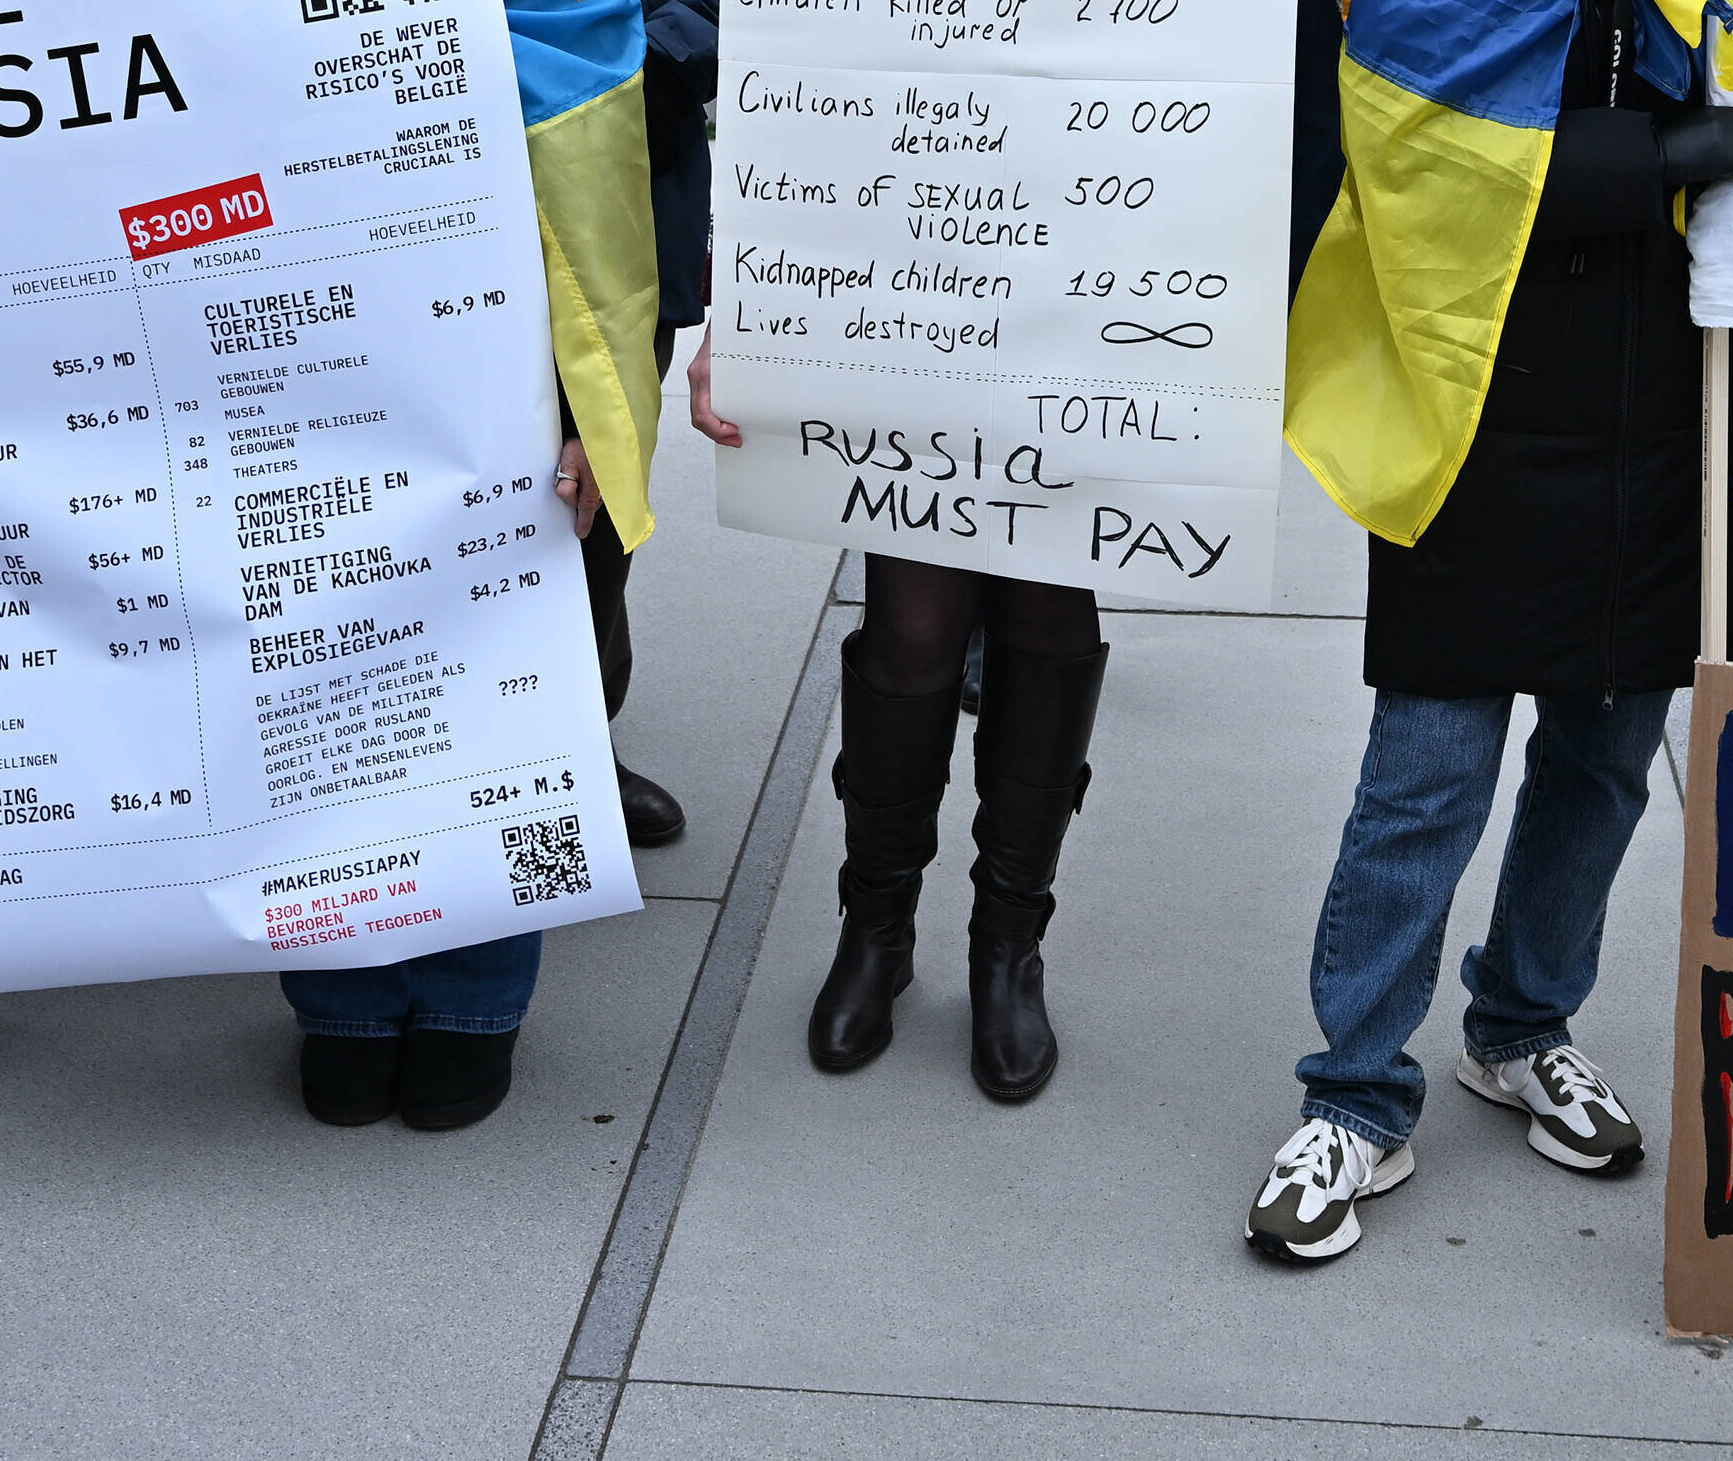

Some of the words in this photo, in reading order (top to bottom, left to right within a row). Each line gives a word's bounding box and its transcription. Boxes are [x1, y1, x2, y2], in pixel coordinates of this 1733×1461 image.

[360, 30, 385, 48] DE
[396, 17, 458, 43] WEVER
[911, 20, 1019, 49] injured
[314, 43, 423, 77] OVERSCHAT
[437, 38, 461, 56] DE
[416, 58, 465, 81] VOOR
[395, 76, 468, 105] BELGIË
[738, 71, 874, 119] Civilians
[896, 88, 990, 126] illegaly
[1067, 101, 1108, 131] 20
[1132, 101, 1210, 133] 000
[892, 126, 1007, 155] detained
[736, 164, 836, 205] Victims
[1065, 176, 1154, 210] 500
[126, 204, 215, 252] $300
[223, 187, 265, 223] MD
[736, 243, 874, 298] Kidnapped
[892, 260, 1012, 299] children
[1065, 270, 1114, 297] 19
[1129, 270, 1227, 299] 500
[737, 301, 808, 336] Lives
[845, 315, 1000, 352] destroyed
[1029, 395, 1200, 443] TOTAL:
[841, 475, 1048, 544] MUST
[1091, 506, 1230, 578] PAY
[470, 781, 522, 810] 524+
[535, 768, 576, 798] M.$
[262, 850, 422, 897] #MAKERUSSIAPAY
